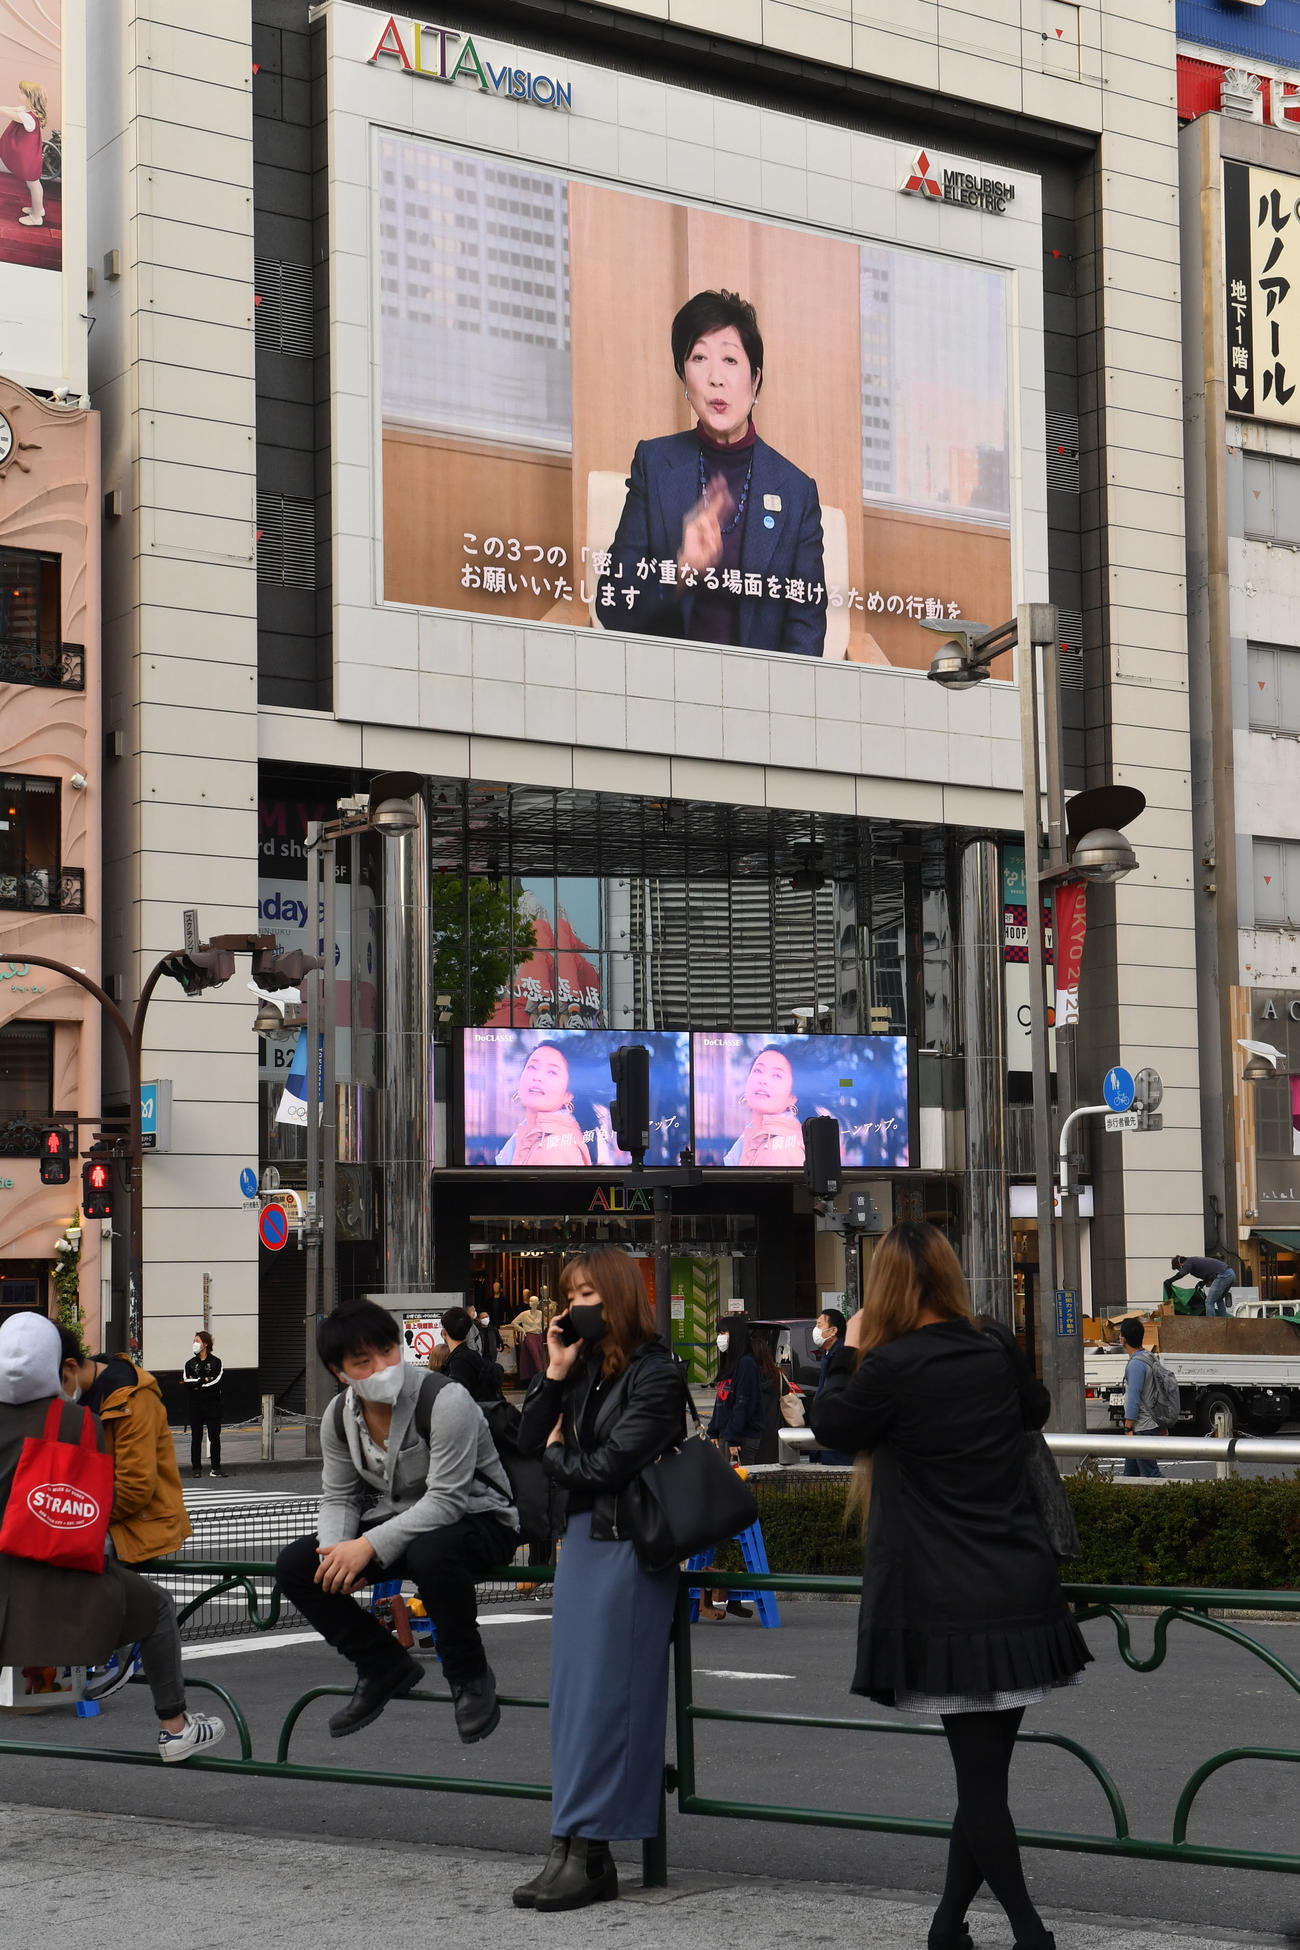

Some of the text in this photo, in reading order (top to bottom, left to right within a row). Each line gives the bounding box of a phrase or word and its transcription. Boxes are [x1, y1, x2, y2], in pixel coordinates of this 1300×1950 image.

[367, 16, 572, 111] ALTA VISION
[943, 168, 1015, 200] MITSUBISHI
[943, 184, 1006, 213] ELECTRIC
[1258, 188, 1296, 406] ルノアール
[1230, 279, 1249, 370] 地下1階
[461, 562, 641, 611] お願いいたします
[474, 1034, 513, 1042] DoCLASSE
[1107, 1116, 1137, 1129] 歩行者優先
[588, 1186, 651, 1211] ALTA
[32, 1491, 95, 1518] STRAND
